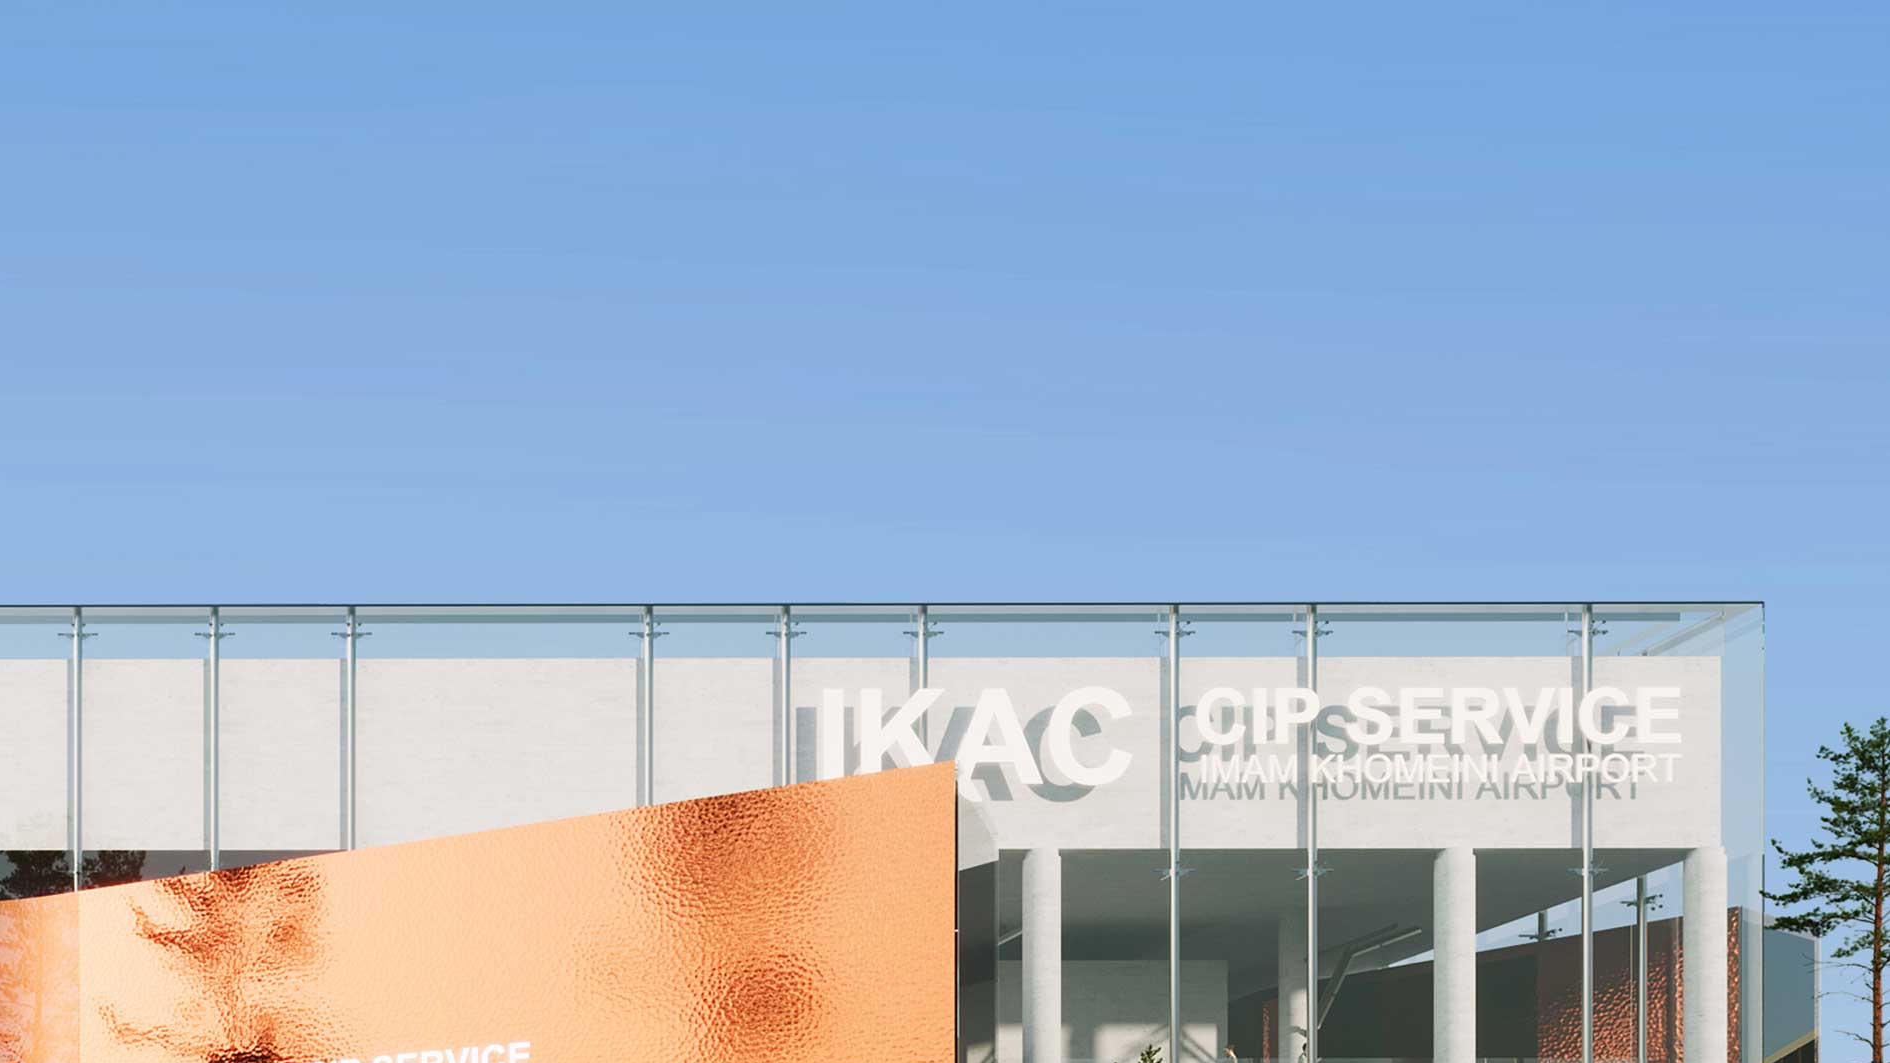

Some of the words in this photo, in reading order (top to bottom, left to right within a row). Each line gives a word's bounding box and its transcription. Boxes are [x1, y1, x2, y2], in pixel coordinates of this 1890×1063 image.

[821, 686, 1134, 787] IKAC
[1196, 686, 1321, 745] CIP
[1346, 686, 1683, 745] SERVICE
[1200, 753, 1297, 784] IMAM
[1311, 753, 1501, 784] KHOMEINI
[1510, 753, 1684, 784] AIRPORT
